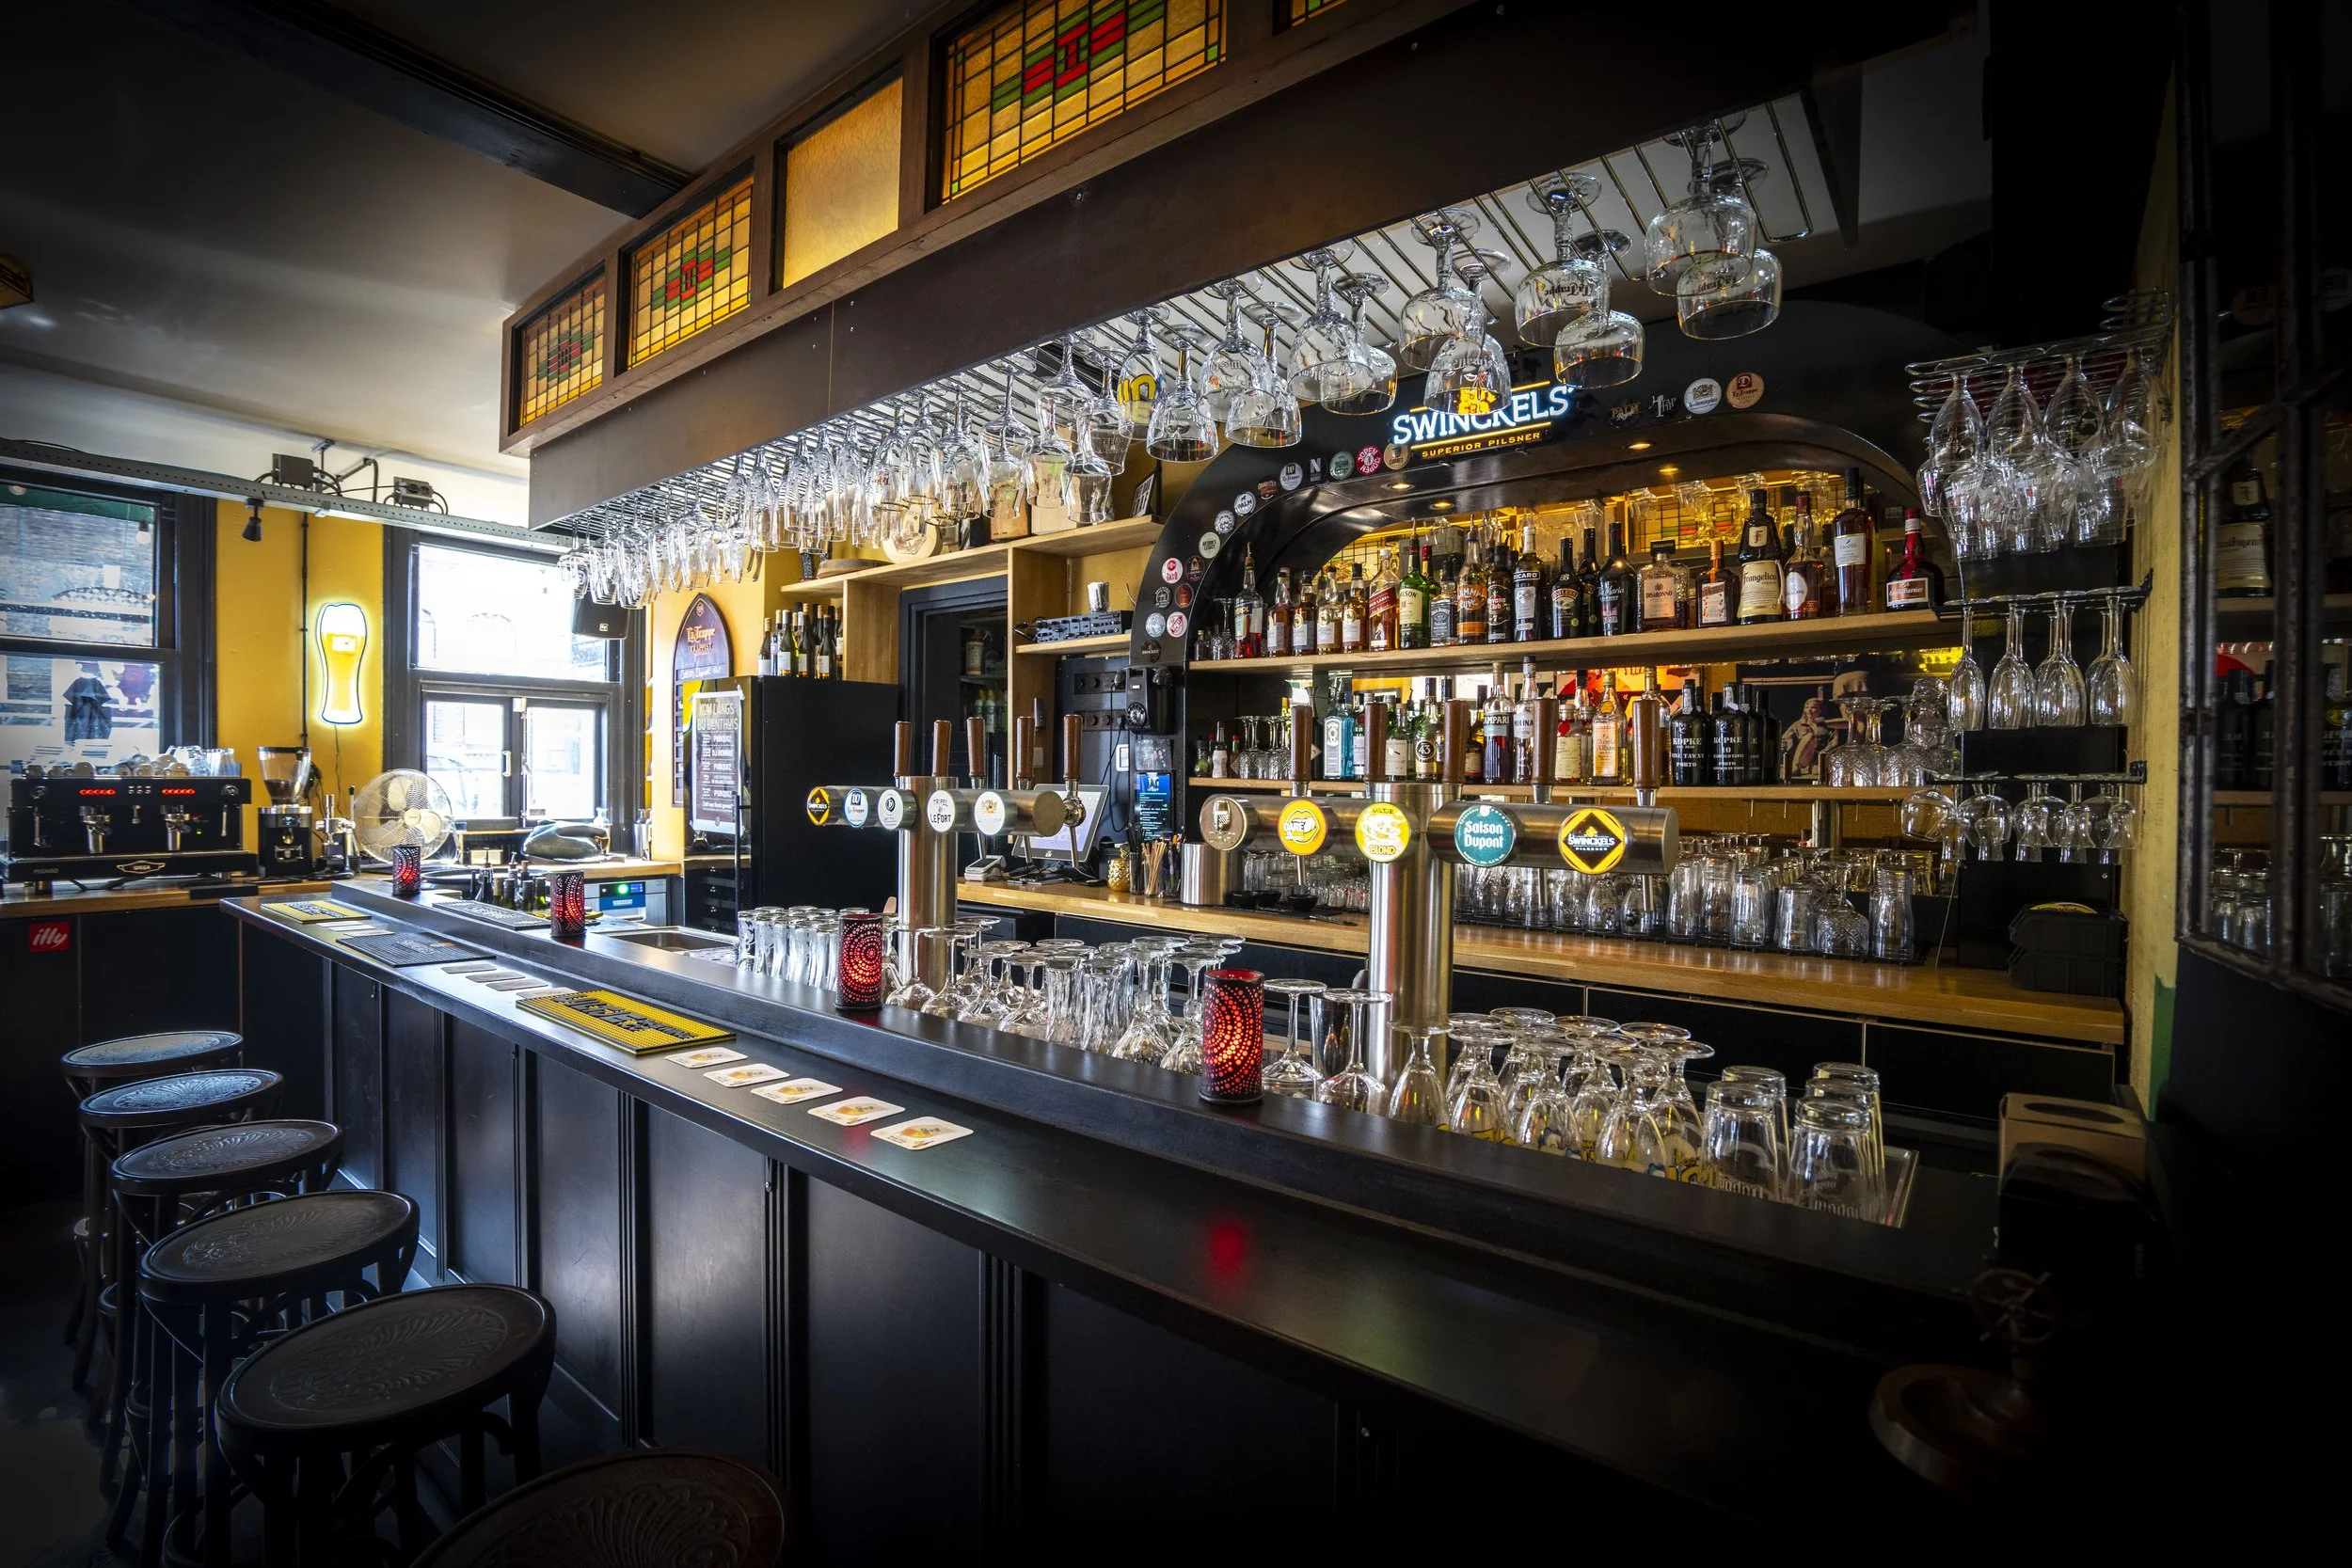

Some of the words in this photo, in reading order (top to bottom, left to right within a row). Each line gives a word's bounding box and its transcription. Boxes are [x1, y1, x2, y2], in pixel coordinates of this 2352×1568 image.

[1422, 442, 1482, 458] SUPERIOR
[1487, 432, 1541, 447] PILSNER
[1358, 446, 1377, 462] JOPEN
[1237, 499, 1252, 509] PALM
[1742, 572, 1777, 585] Frangelico
[1607, 583, 1626, 594] Maria
[1645, 590, 1673, 598] DISARONNO
[712, 702, 735, 716] LANGS
[1484, 716, 1510, 724] AMPARI
[1673, 737, 1702, 746] KOPKE
[1418, 742, 1433, 755] 43
[1283, 821, 1305, 832] DARE
[1464, 820, 1504, 835] Saison
[1464, 834, 1504, 850] Dupont
[1369, 846, 1397, 855] BLOND
[32, 927, 69, 949] illy
